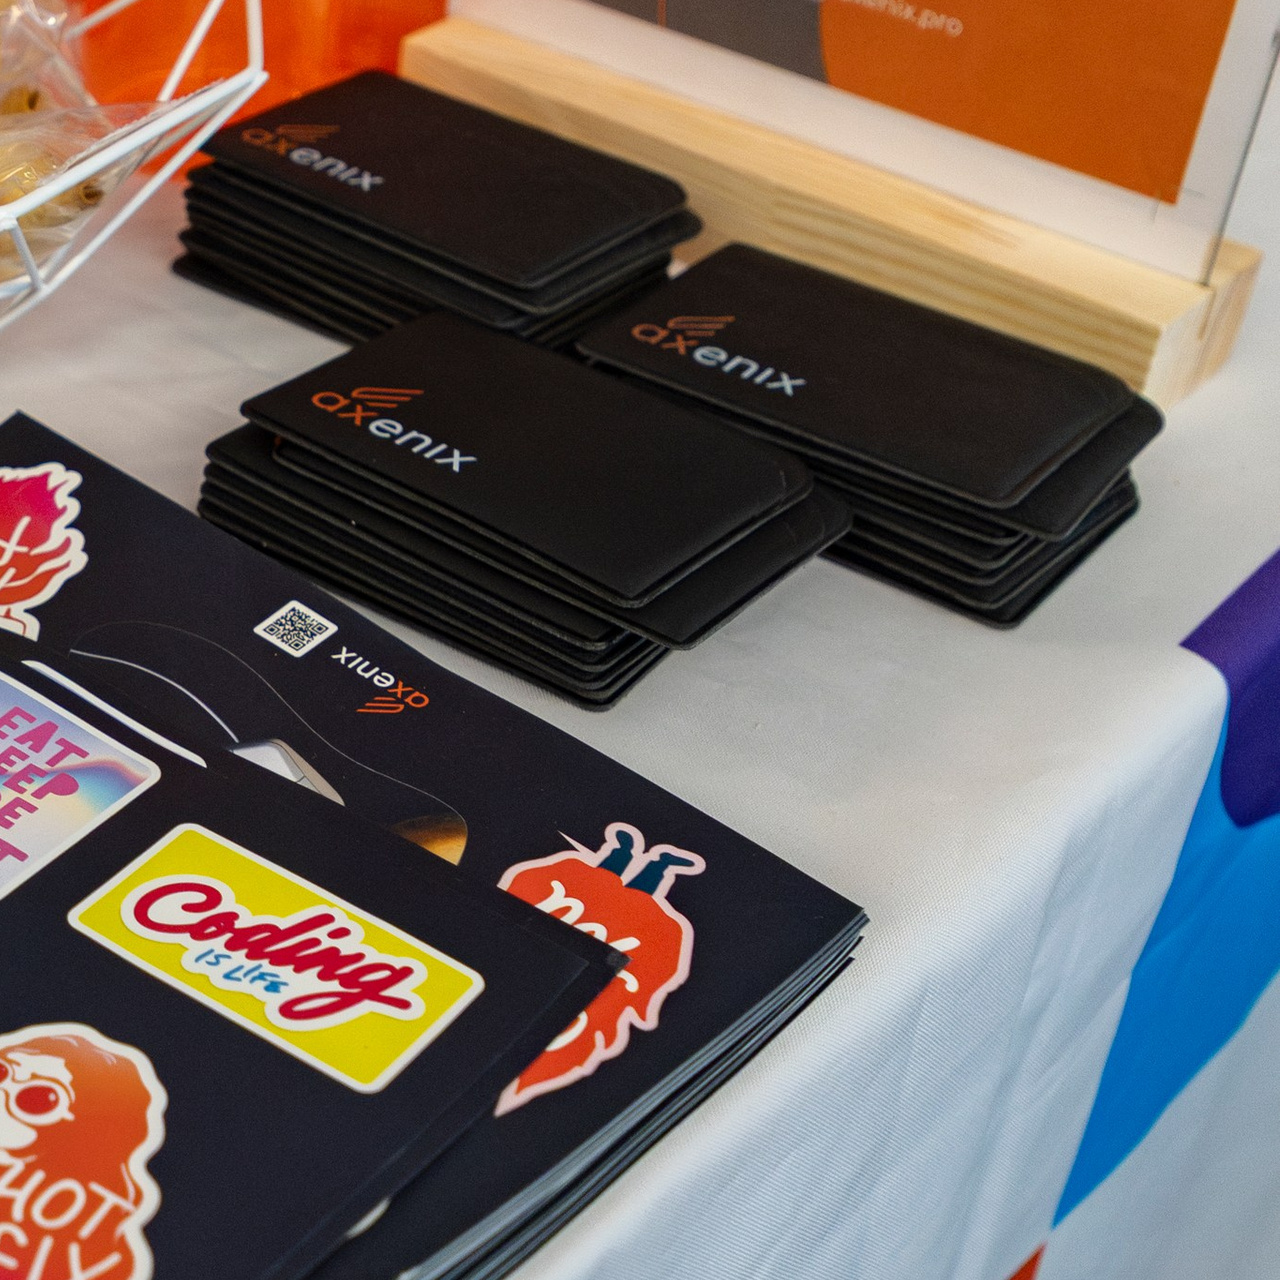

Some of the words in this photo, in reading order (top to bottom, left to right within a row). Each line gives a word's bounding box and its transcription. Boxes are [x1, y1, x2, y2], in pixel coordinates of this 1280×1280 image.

[241, 127, 384, 192] axenix
[631, 322, 807, 398] axenix
[311, 387, 476, 474] axenix
[331, 645, 430, 710] axenix
[133, 882, 413, 1021] Coding
